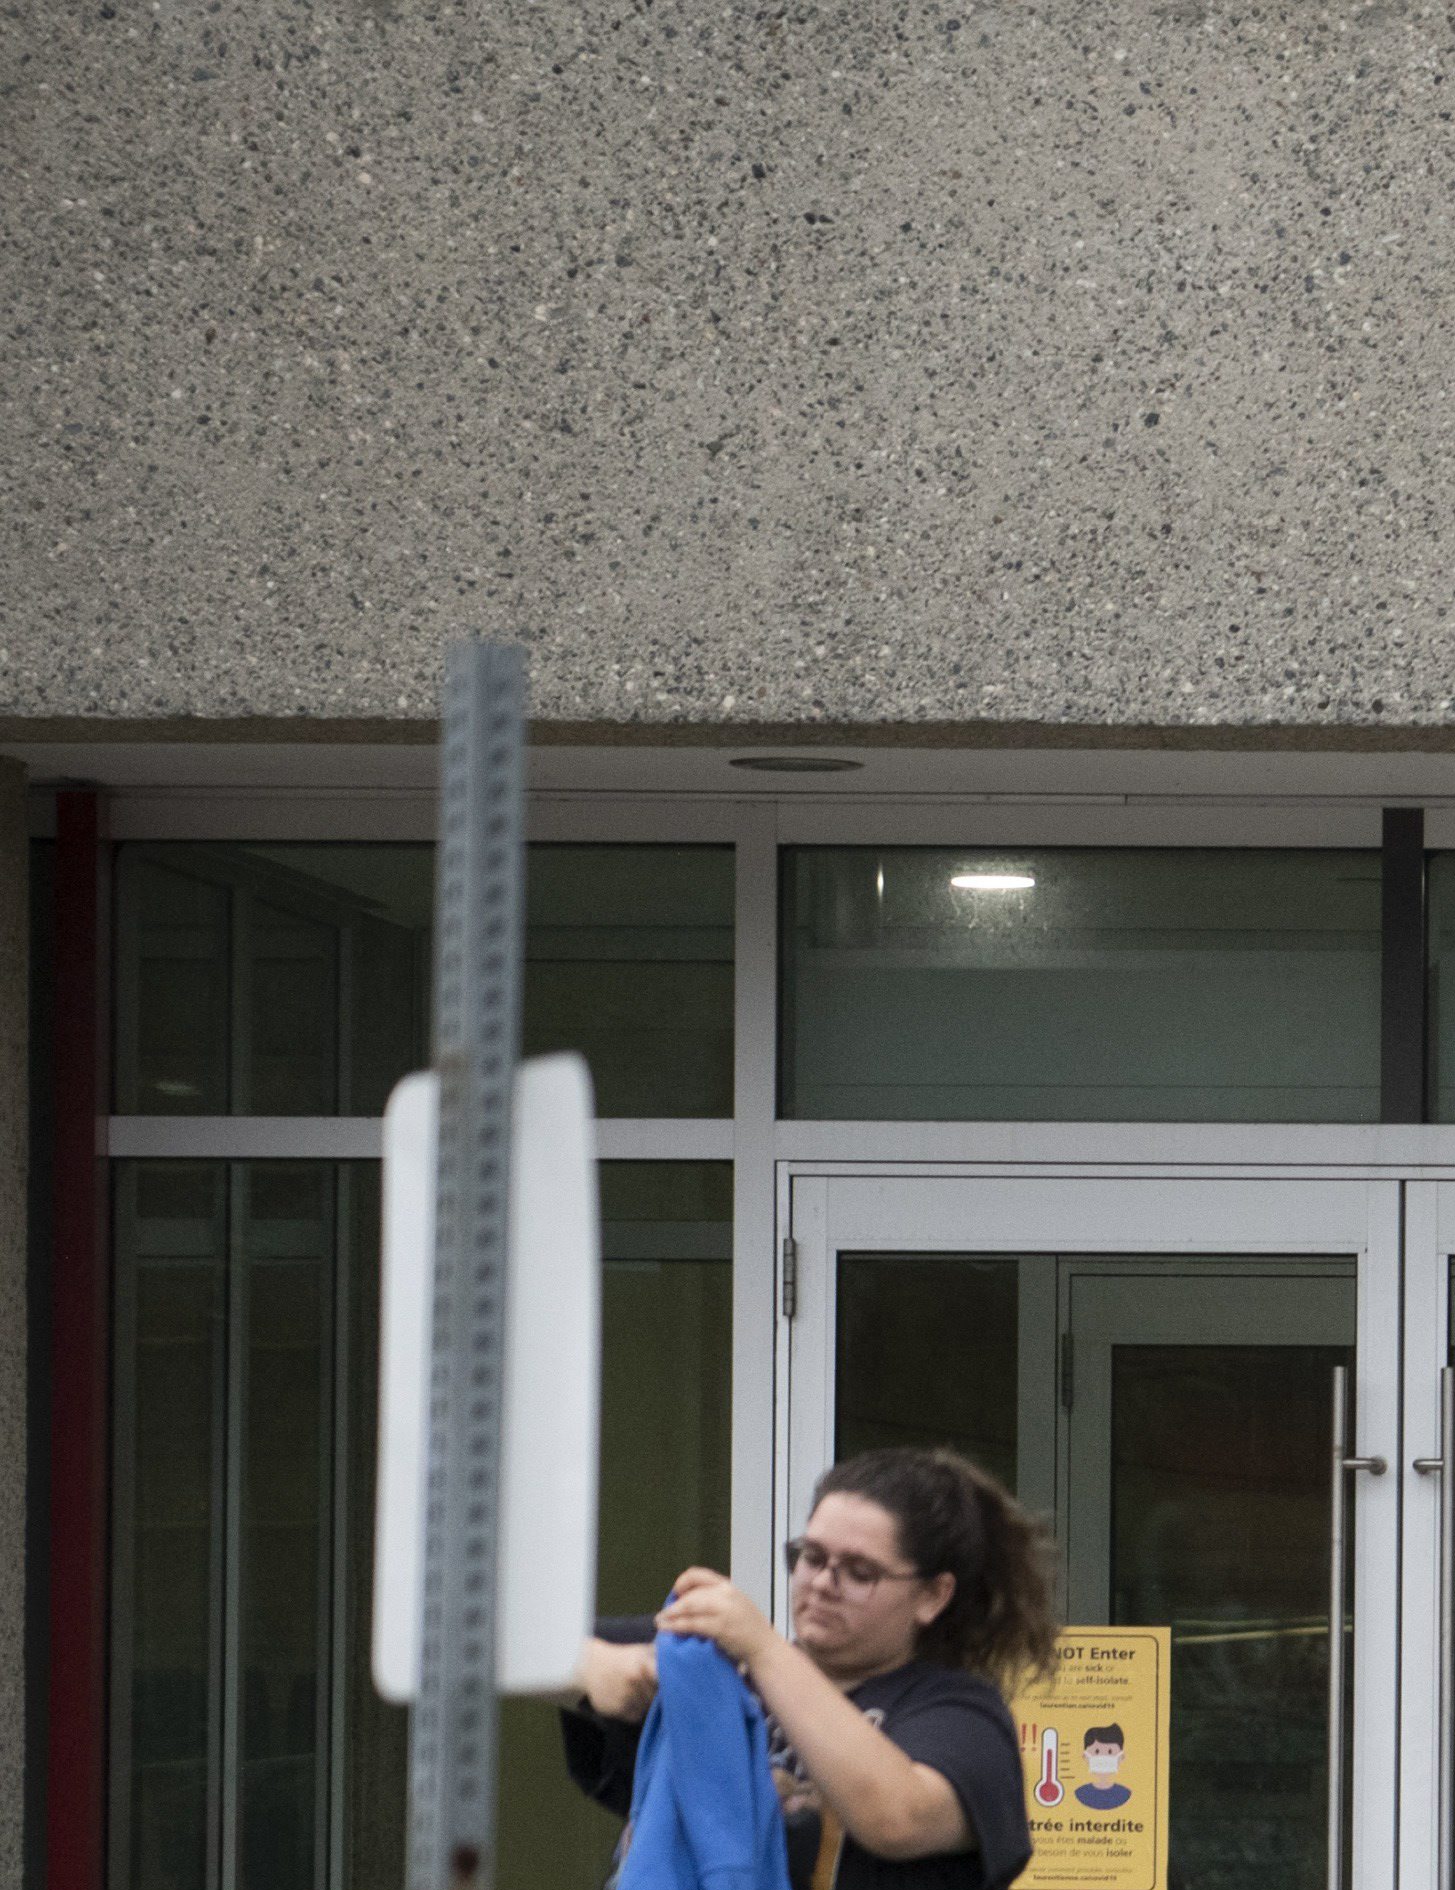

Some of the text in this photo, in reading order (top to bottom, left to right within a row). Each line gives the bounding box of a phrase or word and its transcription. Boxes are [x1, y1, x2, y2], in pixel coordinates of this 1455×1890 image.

[1090, 1647, 1136, 1660] Enter
[1085, 1663, 1103, 1672] sick
[1076, 1675, 1129, 1685] self-isolate
[1029, 1817, 1144, 1833] trée interdite
[1077, 1835, 1112, 1845] malade
[1106, 1848, 1133, 1858] isoler
